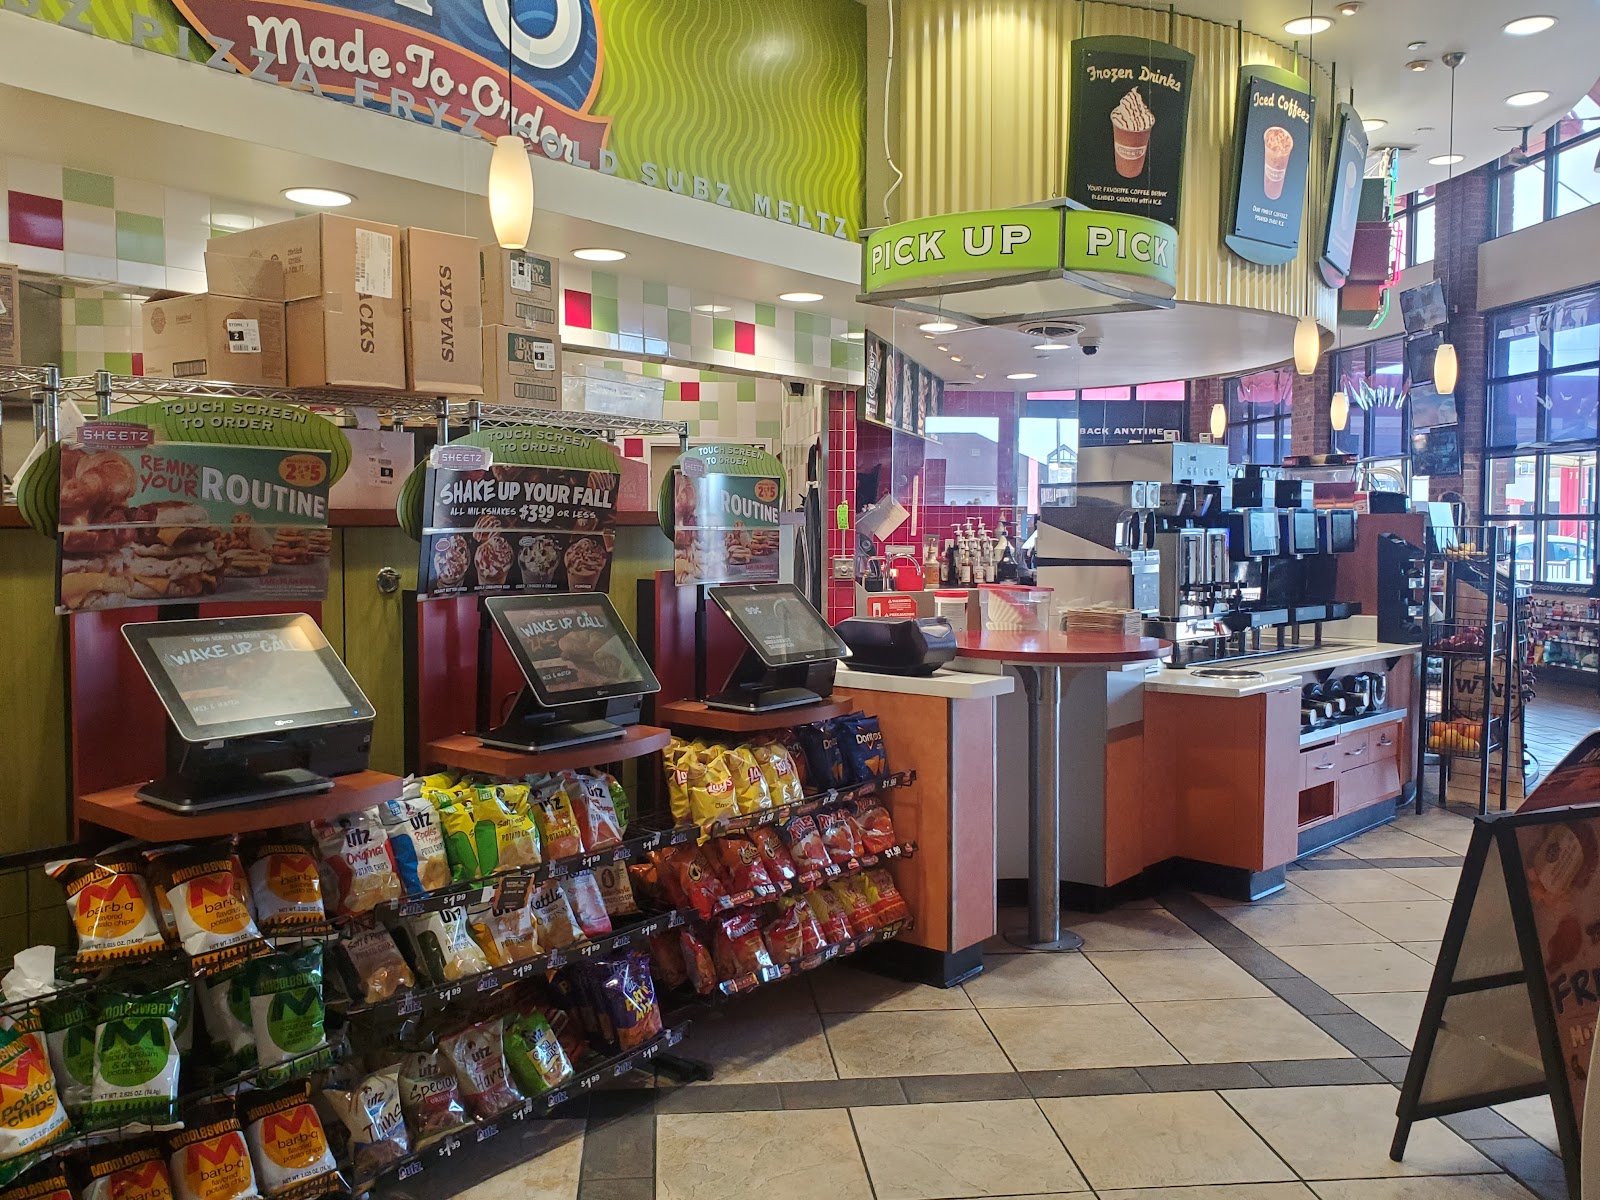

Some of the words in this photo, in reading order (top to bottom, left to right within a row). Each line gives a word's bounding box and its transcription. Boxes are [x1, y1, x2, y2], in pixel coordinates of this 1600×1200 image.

[246, 15, 391, 79] Made
[406, 44, 454, 97] To
[1087, 66, 1133, 83] Frozen
[1138, 65, 1181, 92] Drinks
[1253, 91, 1275, 107] Iced
[1277, 95, 1310, 124] Coffeez
[132, 12, 324, 97] PIZZA
[354, 78, 481, 139] FRYZ
[641, 161, 732, 208] SUBZ
[754, 193, 848, 239] MELTZ
[871, 229, 946, 275] PICK
[963, 223, 1032, 257] UP
[1086, 225, 1168, 269] PICK
[438, 264, 454, 364] SNACKS
[161, 401, 226, 416] TOUCH
[231, 402, 307, 424] SCREEN
[181, 416, 204, 429] TO
[209, 415, 275, 432] ORDER
[1079, 427, 1110, 435] BACK
[1113, 427, 1164, 435] ANYTIME
[83, 429, 149, 441] SHEETZ
[487, 429, 531, 441] TOUCH
[536, 430, 591, 449] SCREEN
[441, 453, 483, 462] SHEETZ
[500, 443, 517, 453] TO
[521, 442, 567, 455] ORDER
[698, 446, 726, 456] TOUCH
[728, 447, 764, 460] SCREEN
[140, 454, 199, 479] REMIX
[705, 456, 716, 465] TO
[719, 457, 749, 466] ORDER
[140, 473, 199, 498] YOUR
[201, 465, 326, 519] ROUTINE
[440, 479, 496, 505] SHAKE
[498, 481, 521, 501] UP
[524, 482, 571, 504] YOUR
[572, 486, 613, 509] FALL
[450, 507, 466, 515] ALL
[467, 507, 517, 516] MILKSHAKES
[557, 509, 569, 518] OR
[572, 510, 597, 519] LESS
[720, 489, 778, 524] ROUTINE
[520, 619, 558, 638] WAKE
[559, 617, 574, 629] UP
[577, 615, 605, 628] CALL
[169, 644, 229, 666] WAKE
[231, 641, 252, 655] UP
[260, 639, 297, 653] CALL
[856, 730, 882, 747] Doritos
[881, 777, 897, 789] $1.99
[758, 812, 775, 825] $1.99
[501, 830, 521, 841] POTATO
[546, 832, 565, 842] POTATO
[345, 845, 384, 865] Original
[884, 845, 901, 858] $1.99
[355, 866, 374, 877] POTATO
[374, 861, 389, 874] CHIPS
[759, 884, 776, 895] $1.99
[531, 889, 562, 910] Kettle
[114, 919, 135, 927] chips
[210, 917, 234, 929] potato
[2, 1080, 52, 1119] potato
[7, 1094, 55, 1128] chips
[283, 1150, 304, 1163] potato
[205, 1183, 230, 1196] potato
